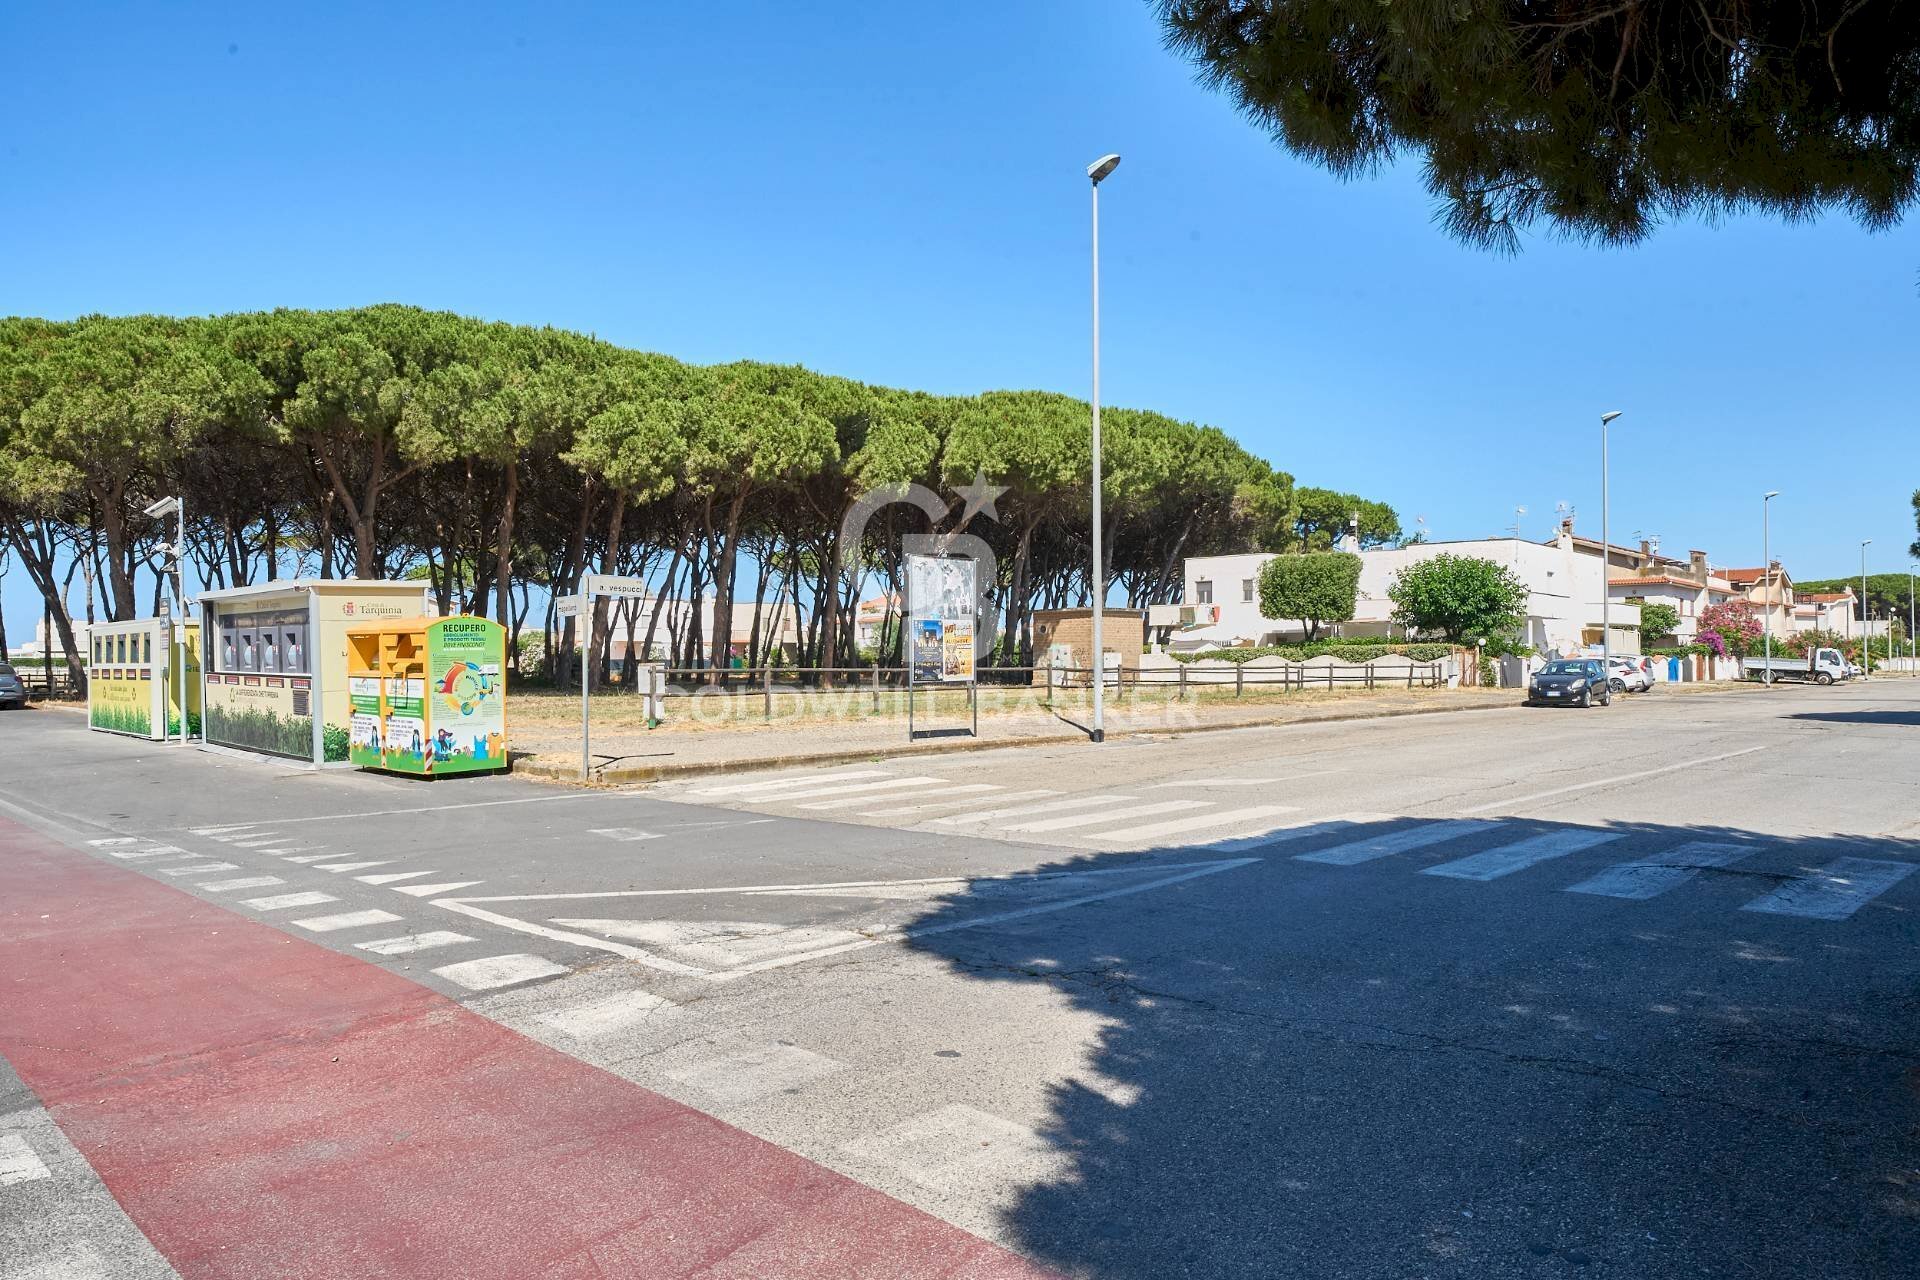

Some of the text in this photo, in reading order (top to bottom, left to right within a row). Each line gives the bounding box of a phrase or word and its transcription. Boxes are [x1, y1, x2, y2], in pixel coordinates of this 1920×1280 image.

[609, 585, 642, 593] vespucci
[360, 605, 402, 616] Tarquinia
[443, 624, 486, 632] RECUPERO
